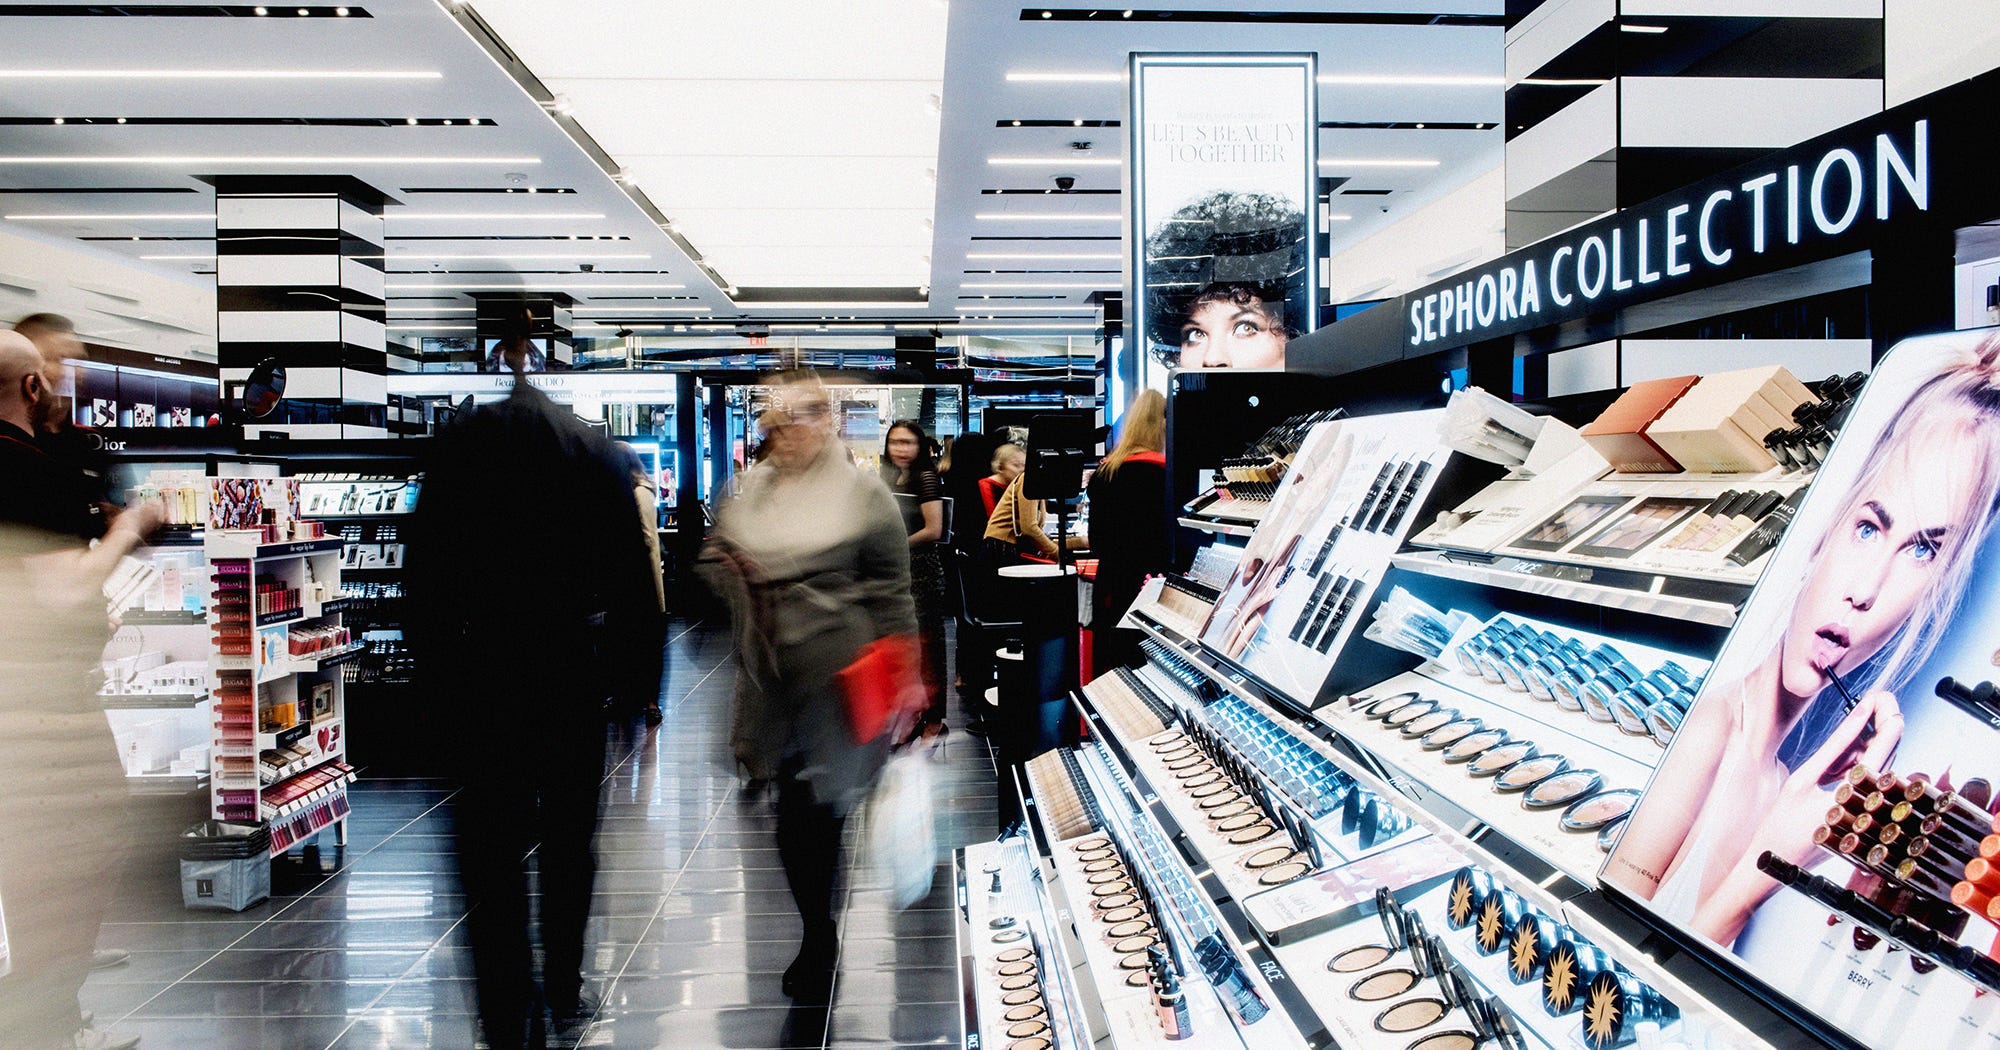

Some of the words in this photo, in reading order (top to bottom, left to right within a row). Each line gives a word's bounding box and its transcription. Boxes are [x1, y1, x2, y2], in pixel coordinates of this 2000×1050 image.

[1213, 123, 1298, 142] BEAUTY
[1166, 144, 1285, 163] TOGETHER
[1410, 259, 1540, 345] SEPHORA
[1549, 119, 1927, 306] COLLECTION
[526, 377, 564, 387] STUDIO
[1260, 961, 1285, 982] FACE
[1847, 970, 1874, 990] BERRY
